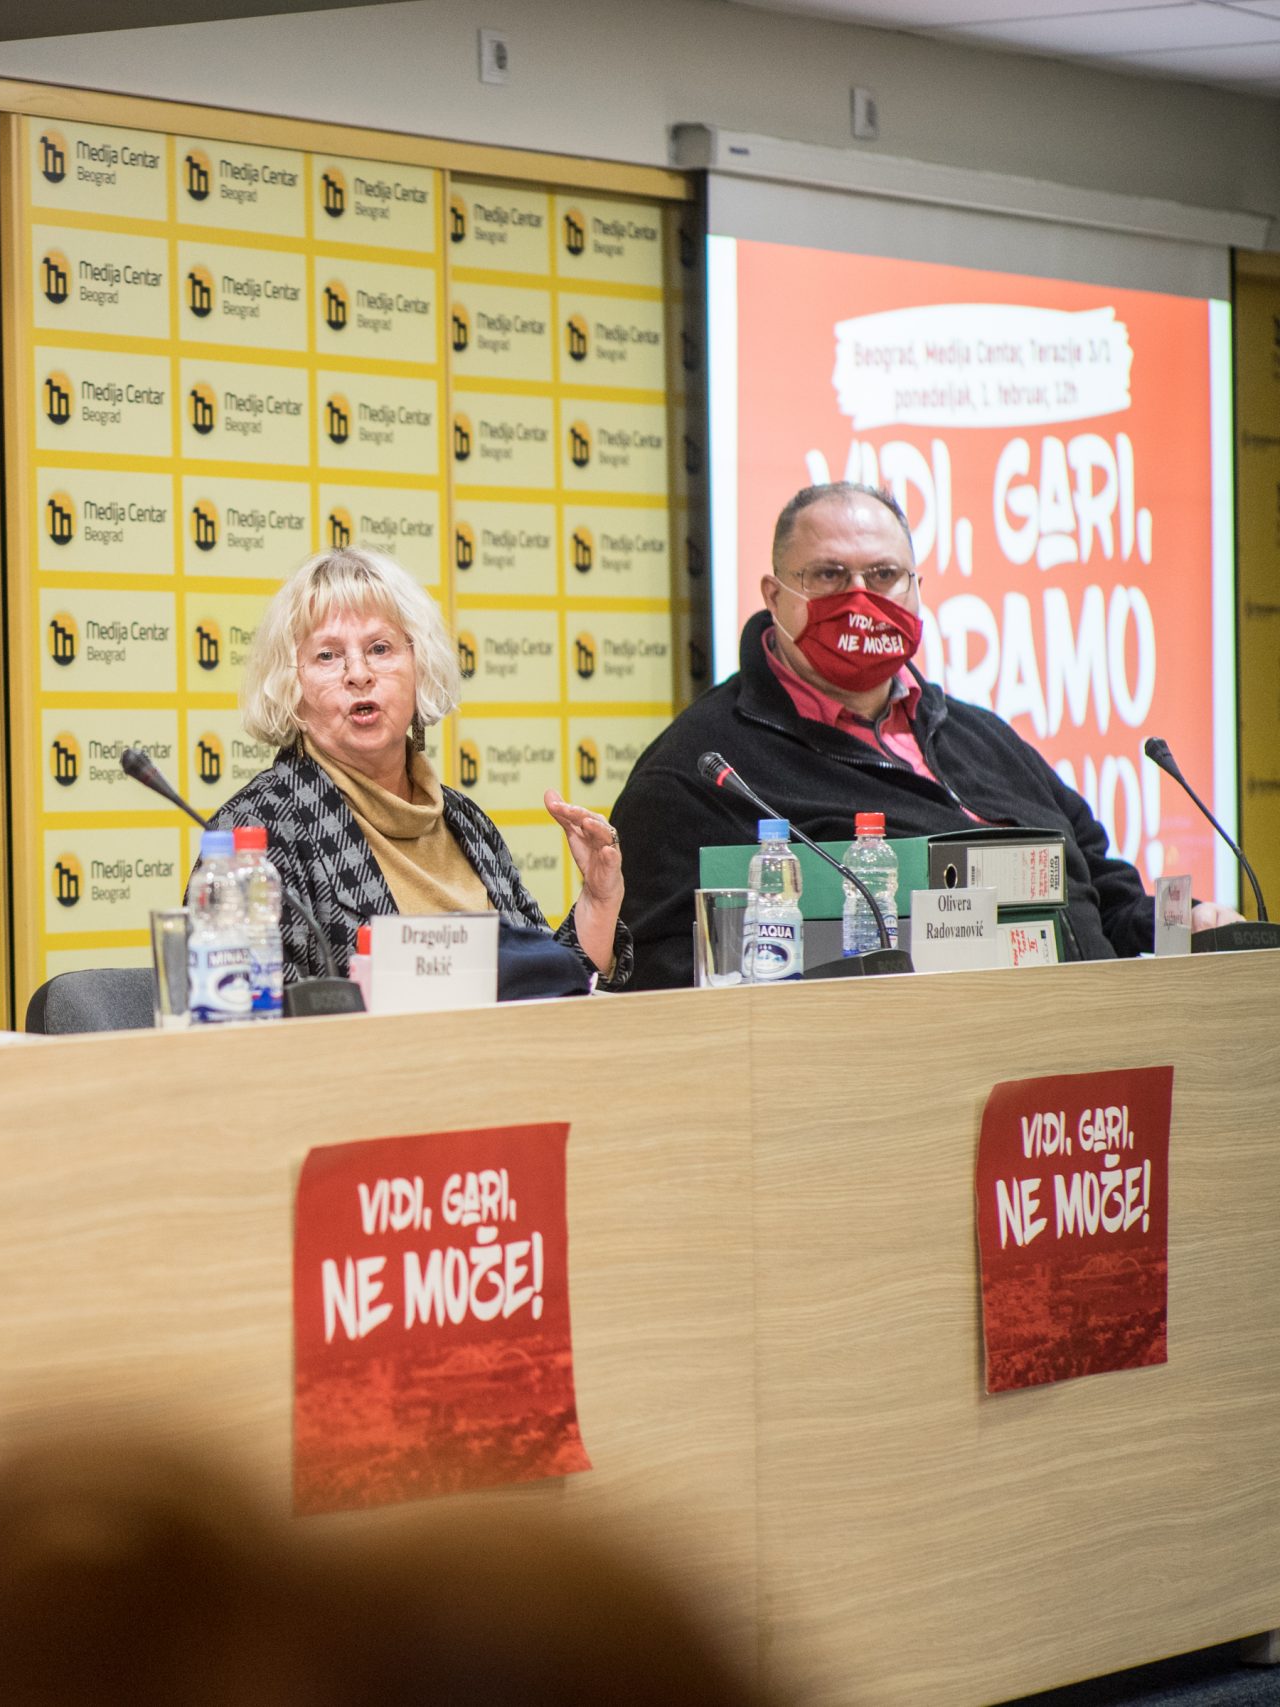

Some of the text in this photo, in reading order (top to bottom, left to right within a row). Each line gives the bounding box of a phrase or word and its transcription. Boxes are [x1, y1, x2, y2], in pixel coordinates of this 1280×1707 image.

[77, 141, 160, 168] Medija Centar
[77, 165, 116, 187] Beograd
[220, 160, 298, 187] Medija Centar
[220, 182, 257, 204] Beograd
[354, 177, 428, 205] Medija Centar
[79, 261, 162, 287] Medija Centar
[80, 285, 118, 306] Beograd
[222, 276, 300, 302] Medija Centar
[223, 299, 259, 319] Beograd
[357, 290, 430, 315] Medija Centar
[82, 381, 164, 407] Medija Centar
[224, 392, 303, 416] Medija Centar
[82, 405, 121, 426] Beograd
[225, 415, 262, 436] Beograd
[359, 403, 432, 428] Medija Centar
[84, 501, 167, 525] Medija Centar
[993, 433, 1152, 571] GARI,
[227, 508, 305, 532] Medija Centar
[361, 515, 434, 538] Medija Centar
[84, 525, 123, 545] Beograd
[227, 533, 264, 551] Beograd
[86, 621, 169, 644] Medija Centar
[848, 613, 874, 632] VIDI,
[838, 633, 859, 652] NE
[87, 646, 126, 664] Beograd
[919, 584, 1157, 740] RAMO
[89, 766, 127, 784] Beogra
[91, 859, 174, 882] Medija Centar
[91, 886, 130, 904] Beograd
[938, 895, 972, 913] Olivera
[401, 924, 468, 949] Dragoljub
[926, 920, 984, 939] Radovanović
[1233, 930, 1277, 946] BOSCH
[1021, 1105, 1134, 1158] VIDI, GARI,
[357, 1167, 517, 1236] VIDI, GARI,
[996, 1154, 1151, 1249] NE MOŽE!
[322, 1226, 544, 1344] NE MOŽE!
